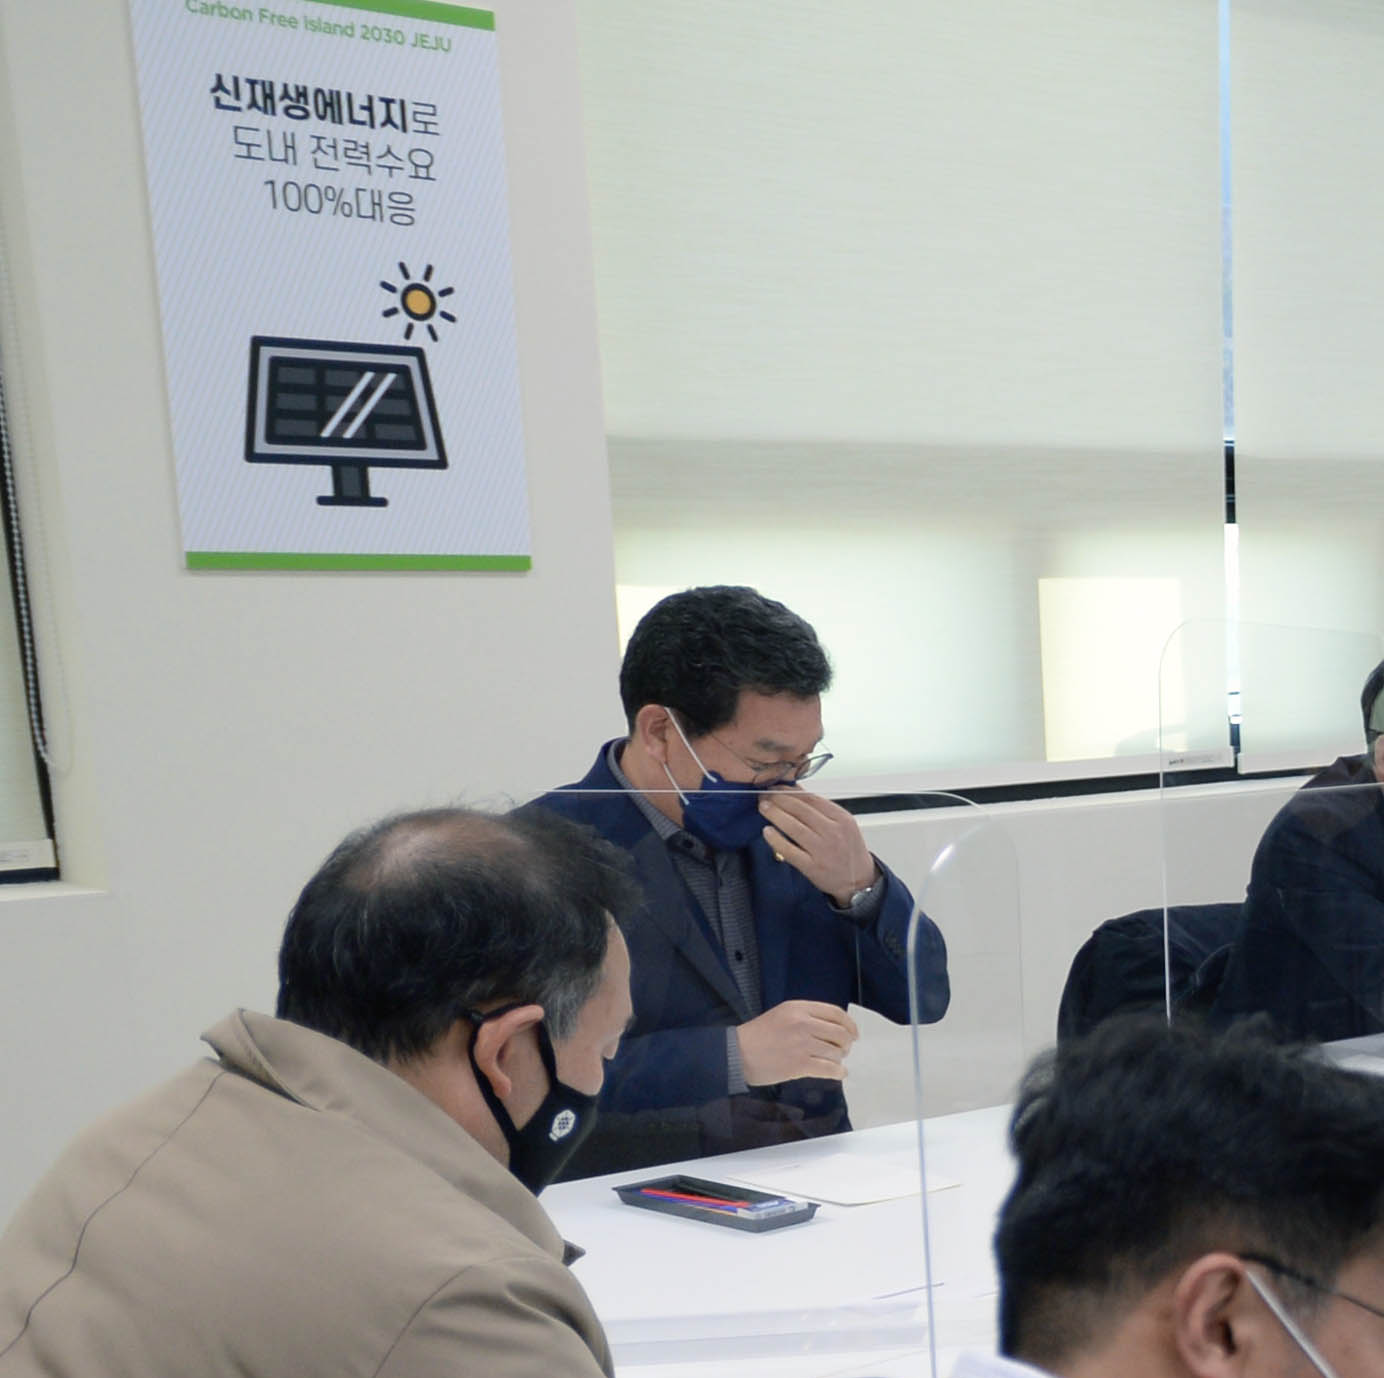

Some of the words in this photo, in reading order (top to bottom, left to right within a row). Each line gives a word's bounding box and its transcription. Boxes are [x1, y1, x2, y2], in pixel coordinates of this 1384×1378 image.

[186, 0, 254, 22] Carbon
[258, 8, 299, 29] Free
[303, 15, 355, 37] Island
[360, 24, 405, 46] 2030
[411, 33, 452, 52] JEJU
[209, 72, 440, 136] 신재생에너지로
[233, 125, 298, 165] 도내
[309, 134, 437, 181] 전력수요
[264, 179, 416, 227] 100%대응
